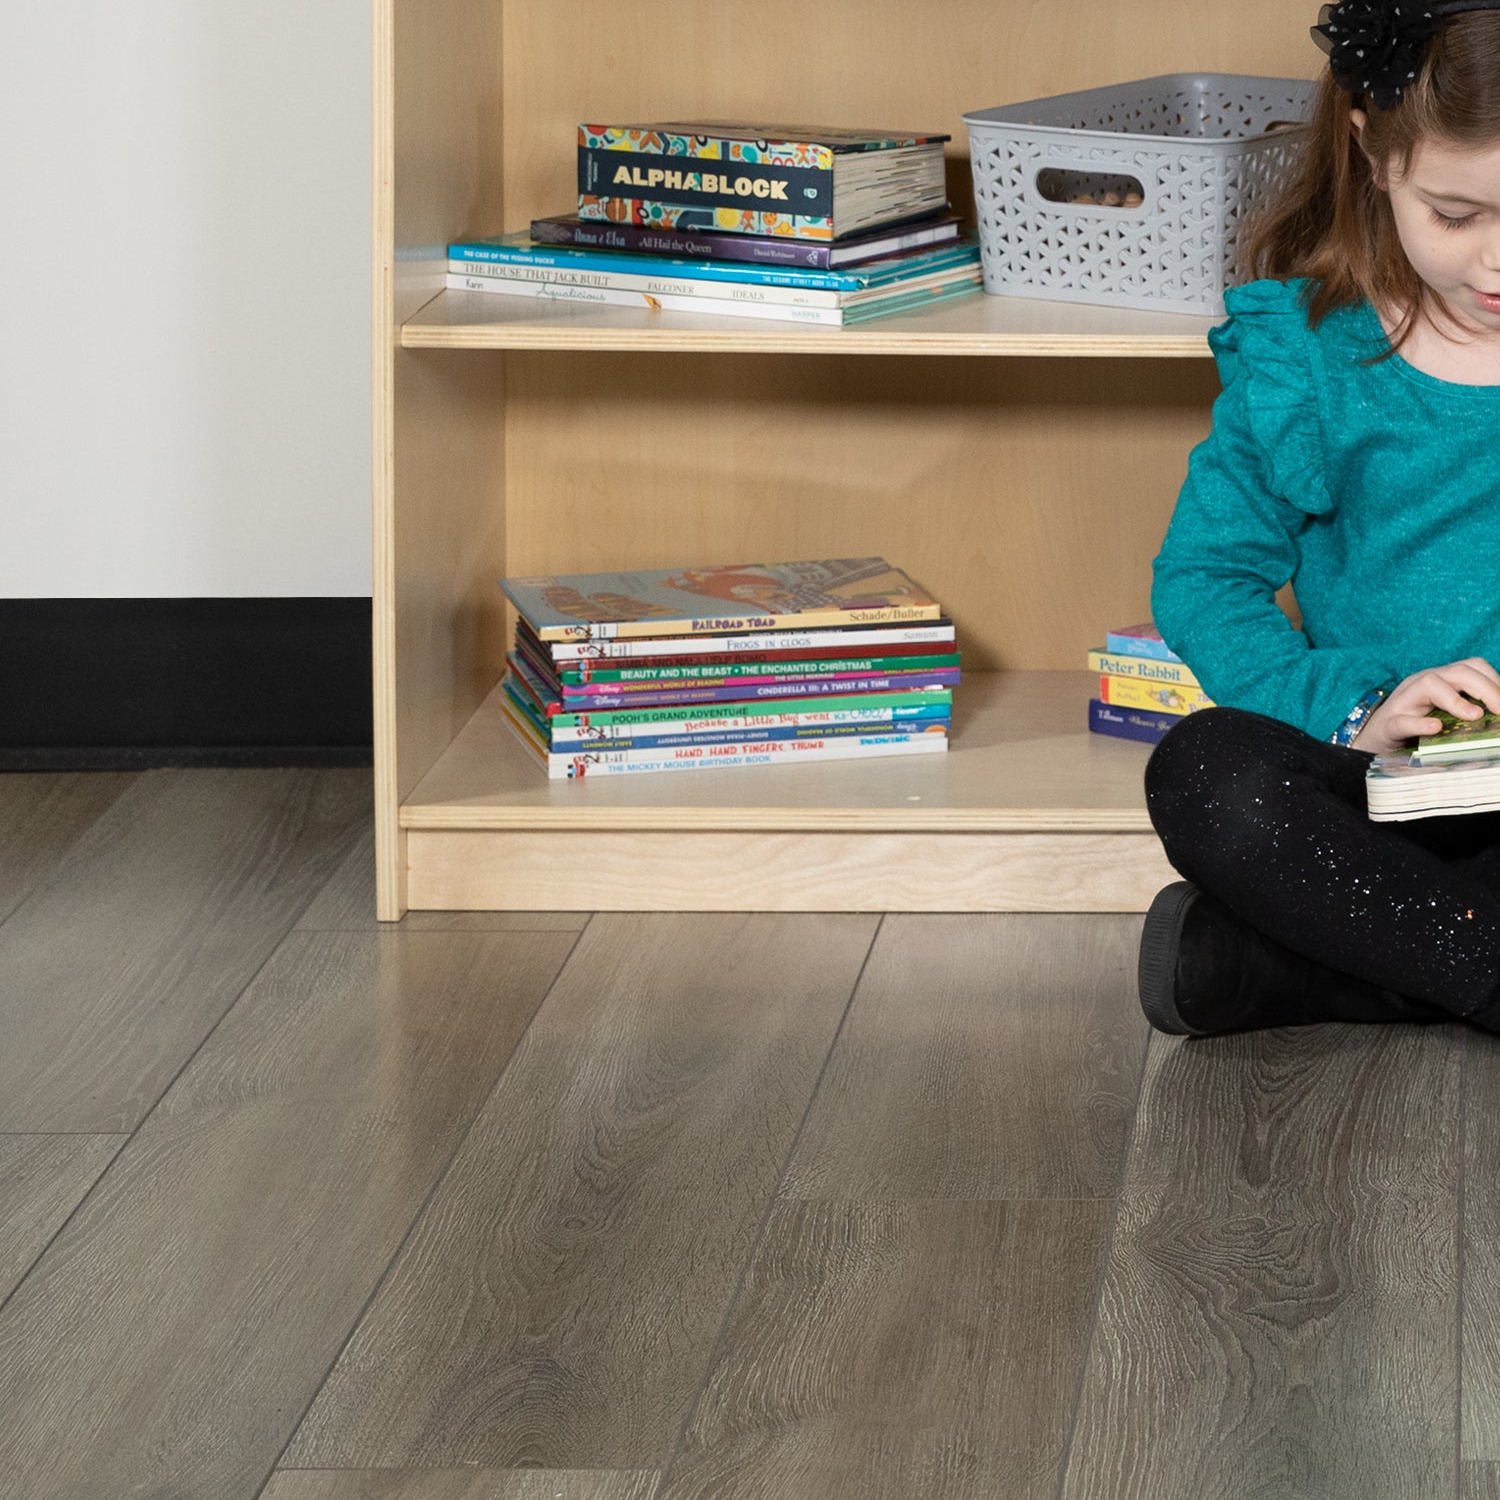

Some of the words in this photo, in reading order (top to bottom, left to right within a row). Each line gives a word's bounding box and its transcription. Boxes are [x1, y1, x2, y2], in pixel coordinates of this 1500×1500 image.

[613, 165, 789, 200] ALPHABLOCK
[574, 228, 597, 244] Anna
[606, 230, 625, 245] Elsa
[639, 237, 652, 247] All
[654, 238, 671, 249] Hail
[672, 240, 684, 251] the
[685, 241, 712, 253] Queen
[464, 262, 485, 274] THE
[487, 264, 521, 278] HOUSE
[524, 269, 551, 281] THAT
[554, 272, 578, 284] JACK
[580, 274, 610, 286] BUILT
[536, 283, 606, 301] Aqualicious
[648, 282, 694, 293] FALCONER
[732, 290, 765, 300] IDEALS
[792, 310, 820, 319] HARPER
[692, 620, 743, 631] RAILROAD
[746, 618, 776, 628] TOAD
[727, 640, 760, 650] FROGS
[765, 639, 775, 647] IN
[780, 638, 811, 647] CLOGS
[620, 670, 656, 679] BEAUTY
[659, 669, 679, 678] AND
[682, 668, 700, 678] THE
[702, 666, 732, 676] BEAST
[741, 666, 759, 674] THE
[761, 663, 818, 673] ENCHANTED
[819, 660, 872, 671] CHRISTMAS
[1099, 658, 1134, 675] Peter
[1138, 661, 1181, 682] Rabbit
[757, 686, 806, 695] CINDERELLA
[832, 682, 856, 690] TWIST
[870, 680, 889, 688] TIME
[594, 696, 620, 706] Disney
[612, 714, 649, 724] POOH'S
[652, 711, 687, 722] GRAND
[690, 708, 749, 719] ADVENTURE
[685, 718, 728, 732] Because
[743, 716, 774, 726] Little
[778, 713, 799, 726] Bug
[675, 749, 703, 758] HAND
[710, 746, 737, 756] HAND
[742, 743, 784, 754] FINGERS
[627, 763, 660, 771] MICKEY
[663, 760, 695, 769] MOUSE
[699, 756, 742, 766] BIRTHDAY
[745, 755, 771, 763] BOOK
